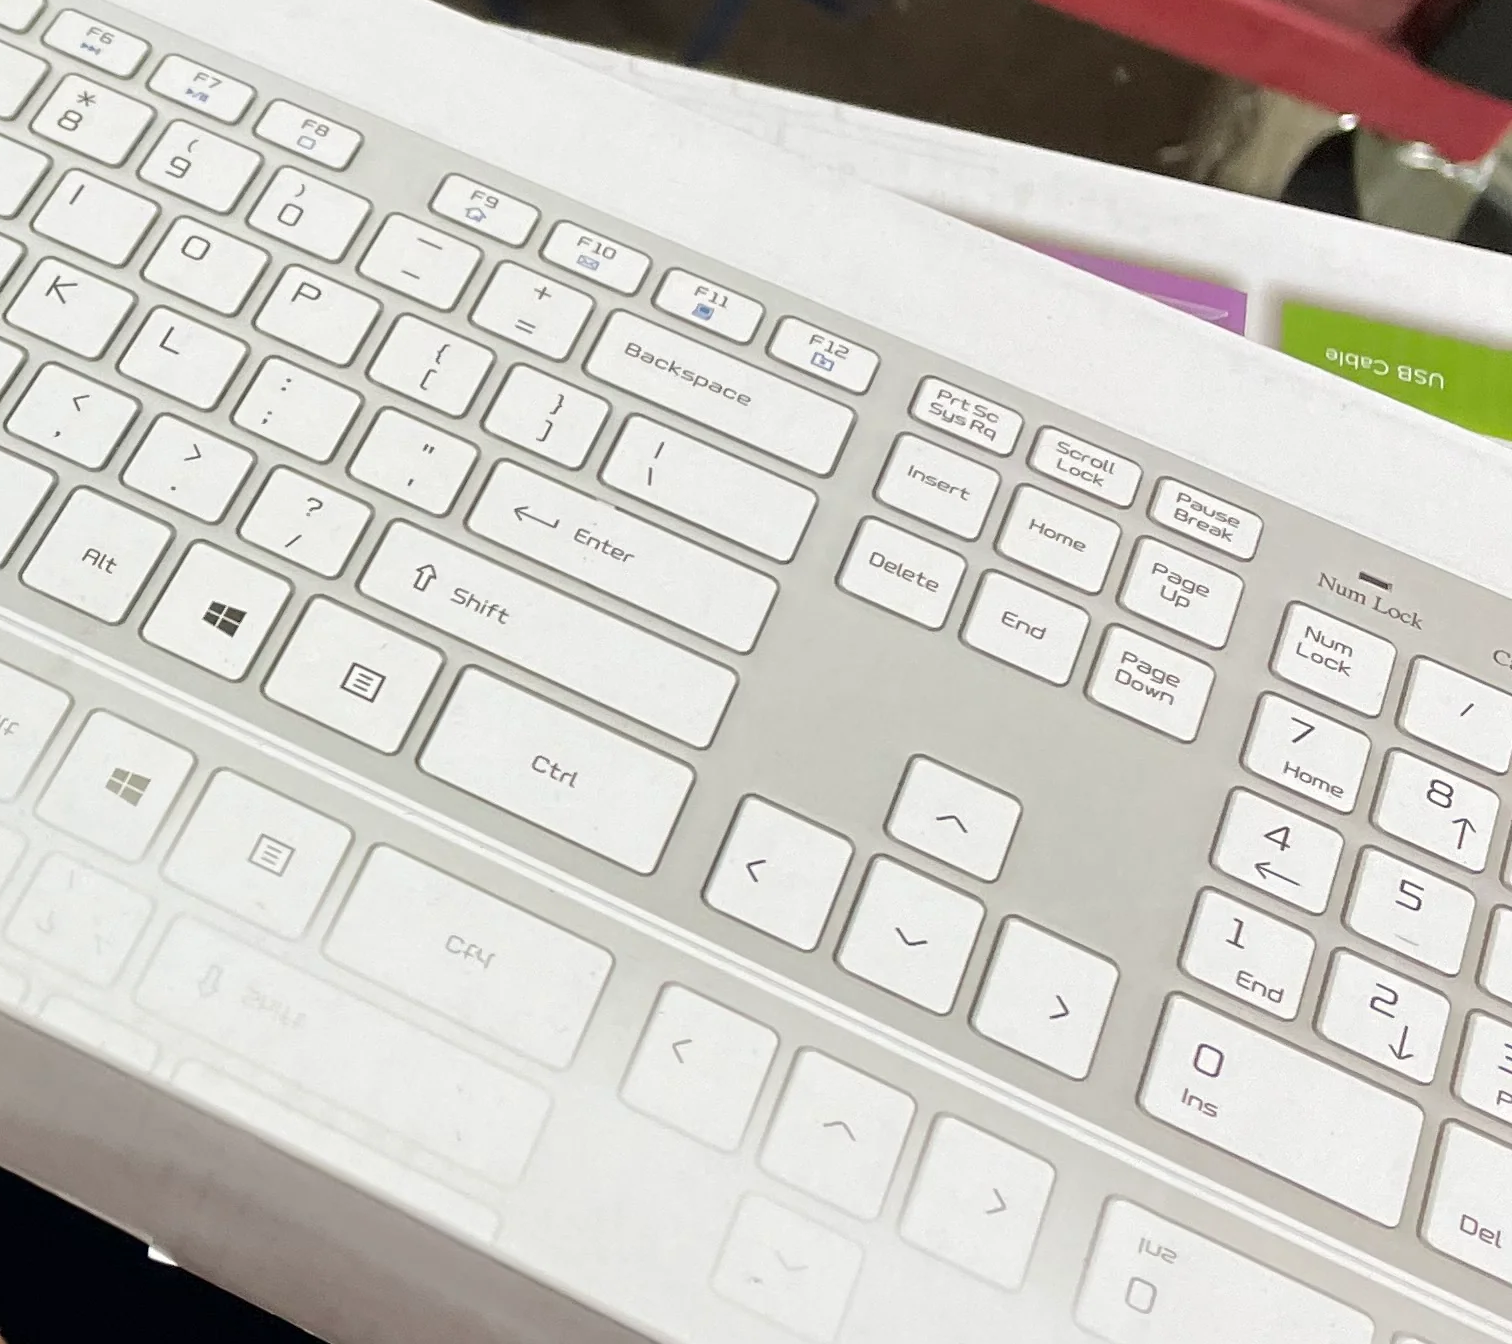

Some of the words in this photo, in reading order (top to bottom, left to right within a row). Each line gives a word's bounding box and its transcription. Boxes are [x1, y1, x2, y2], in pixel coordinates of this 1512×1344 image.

[85, 26, 115, 45] F6
[192, 71, 223, 89] F7
[56, 109, 84, 132] 8
[300, 118, 331, 138] F8
[165, 155, 193, 179] 9
[469, 189, 500, 210] F9
[576, 235, 618, 260] F10
[44, 275, 78, 305] K
[290, 281, 323, 303] P
[694, 285, 729, 309] F11
[158, 326, 180, 356] L
[808, 333, 850, 360] F12
[624, 342, 752, 407] Backspace
[1325, 346, 1390, 377] Cable
[1397, 366, 1446, 390] USB
[929, 402, 967, 427] Sys
[970, 420, 997, 441] Rq
[936, 388, 971, 412] Prt
[972, 404, 1000, 424] Sc
[1056, 440, 1116, 475] Scroll
[1056, 457, 1109, 487] Lock
[907, 464, 970, 502] Insert
[305, 496, 324, 517] ?
[1173, 491, 1241, 529] Pause
[1028, 518, 1087, 553] Home
[1173, 507, 1233, 543] Break
[81, 547, 117, 575] Alt
[573, 527, 635, 563] Enter
[868, 551, 940, 593] Delete
[1152, 562, 1210, 598] Page
[450, 587, 510, 625] Shift
[1159, 586, 1191, 609] Up
[1317, 572, 1368, 607] Num
[1372, 596, 1424, 630] Lock
[1000, 610, 1047, 641] End
[1304, 625, 1354, 657] Num
[1120, 651, 1181, 688] Page
[1295, 642, 1353, 677] Lock
[1115, 669, 1174, 706] Down
[1291, 716, 1316, 744] 7
[531, 754, 578, 788] Ctrl
[1282, 760, 1345, 799] Home
[1426, 778, 1455, 809] 8
[1263, 825, 1291, 852] 4
[1395, 878, 1425, 912] 5
[1225, 917, 1245, 950] 1
[1235, 969, 1285, 1004] End
[1369, 982, 1399, 1019] 2
[1181, 1087, 1219, 1118] Ins
[1459, 1213, 1502, 1249] Del
